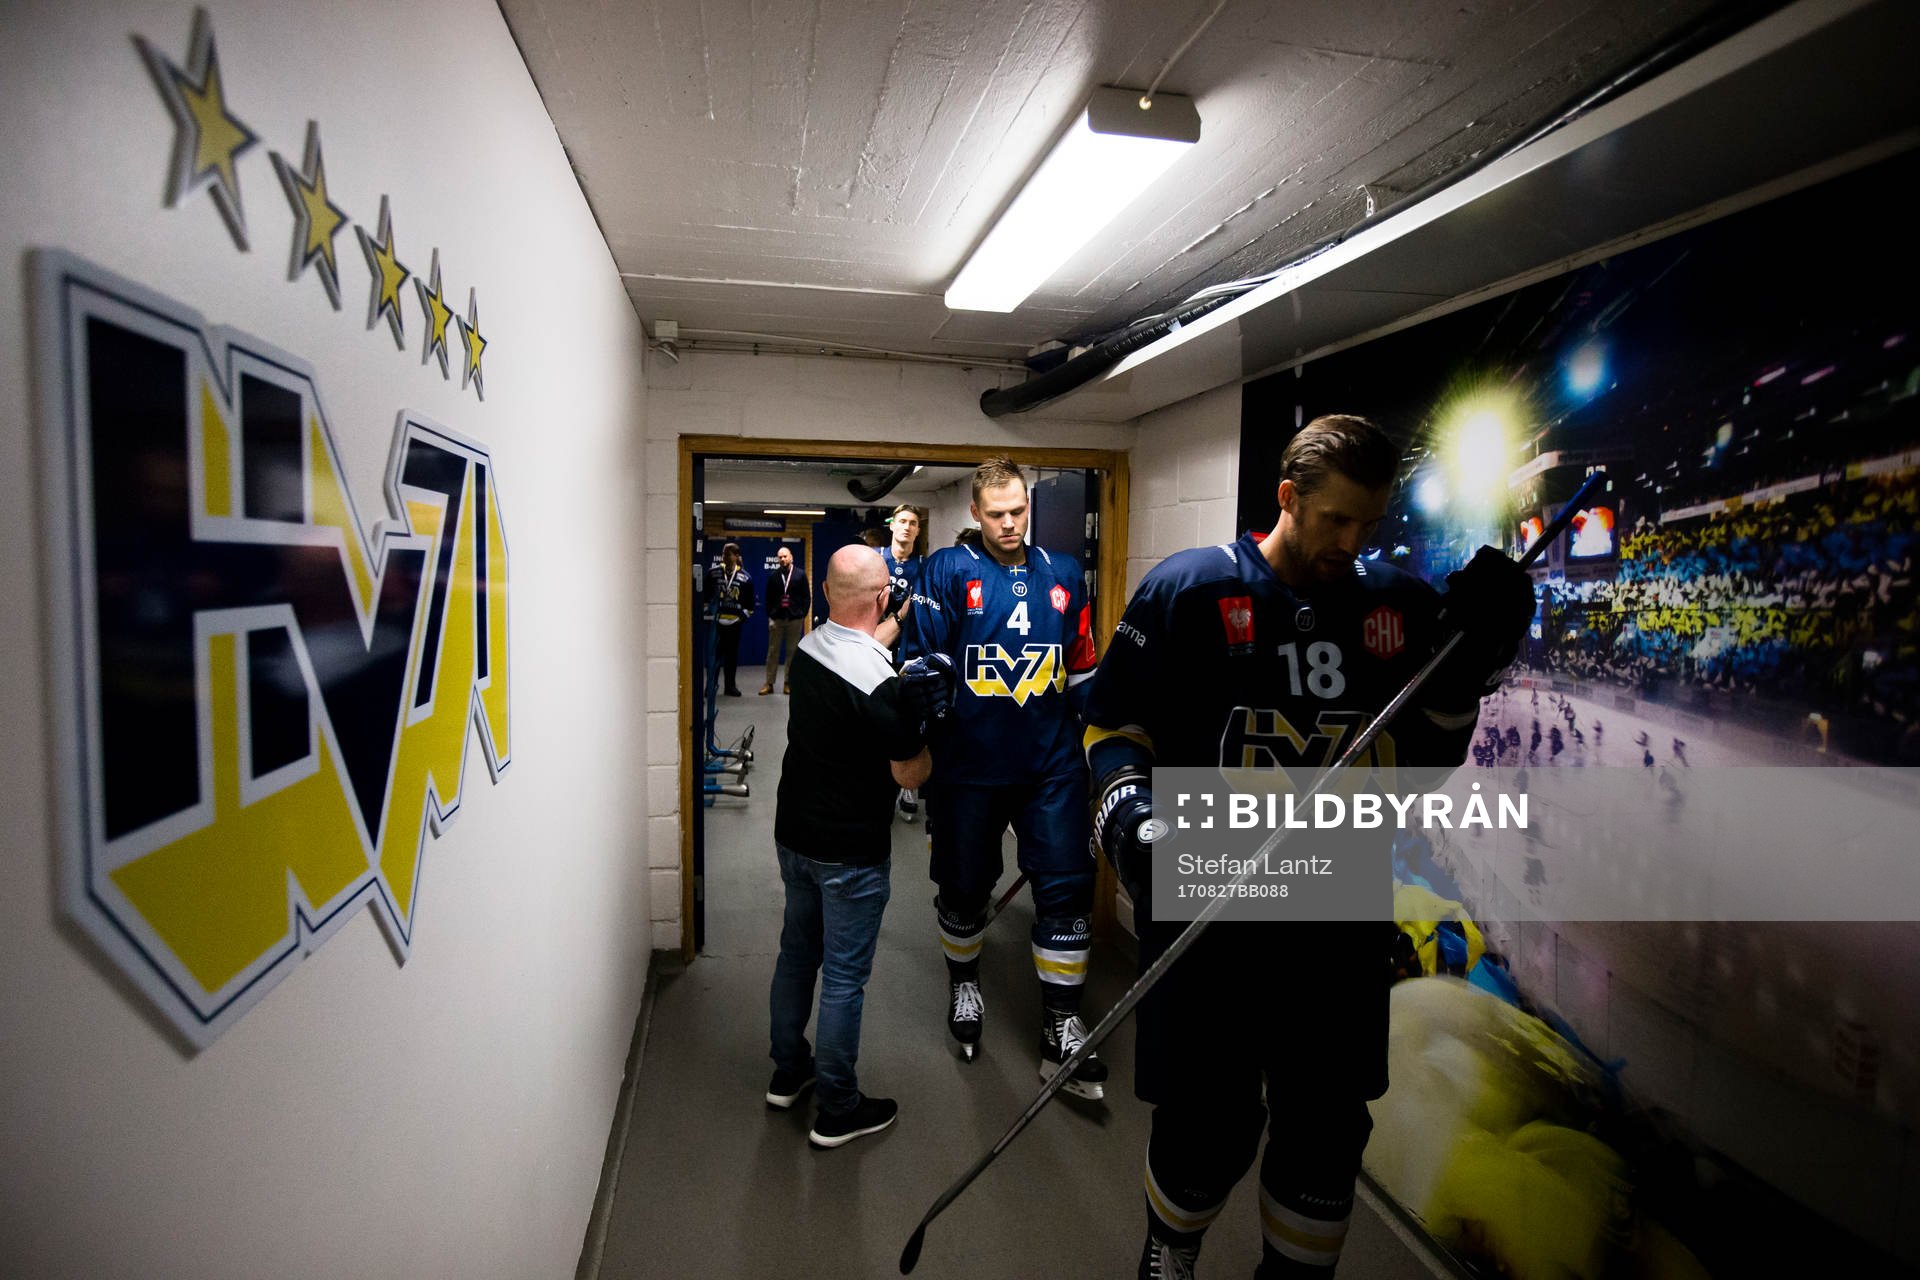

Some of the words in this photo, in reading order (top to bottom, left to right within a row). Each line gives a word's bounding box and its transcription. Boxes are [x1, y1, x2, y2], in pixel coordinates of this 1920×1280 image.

[1006, 600, 1032, 636] 4
[1116, 620, 1147, 649] arna
[1363, 610, 1405, 654] CHL
[45, 262, 511, 1042] HV71
[965, 643, 1067, 707] HV71
[1277, 640, 1346, 699] 18
